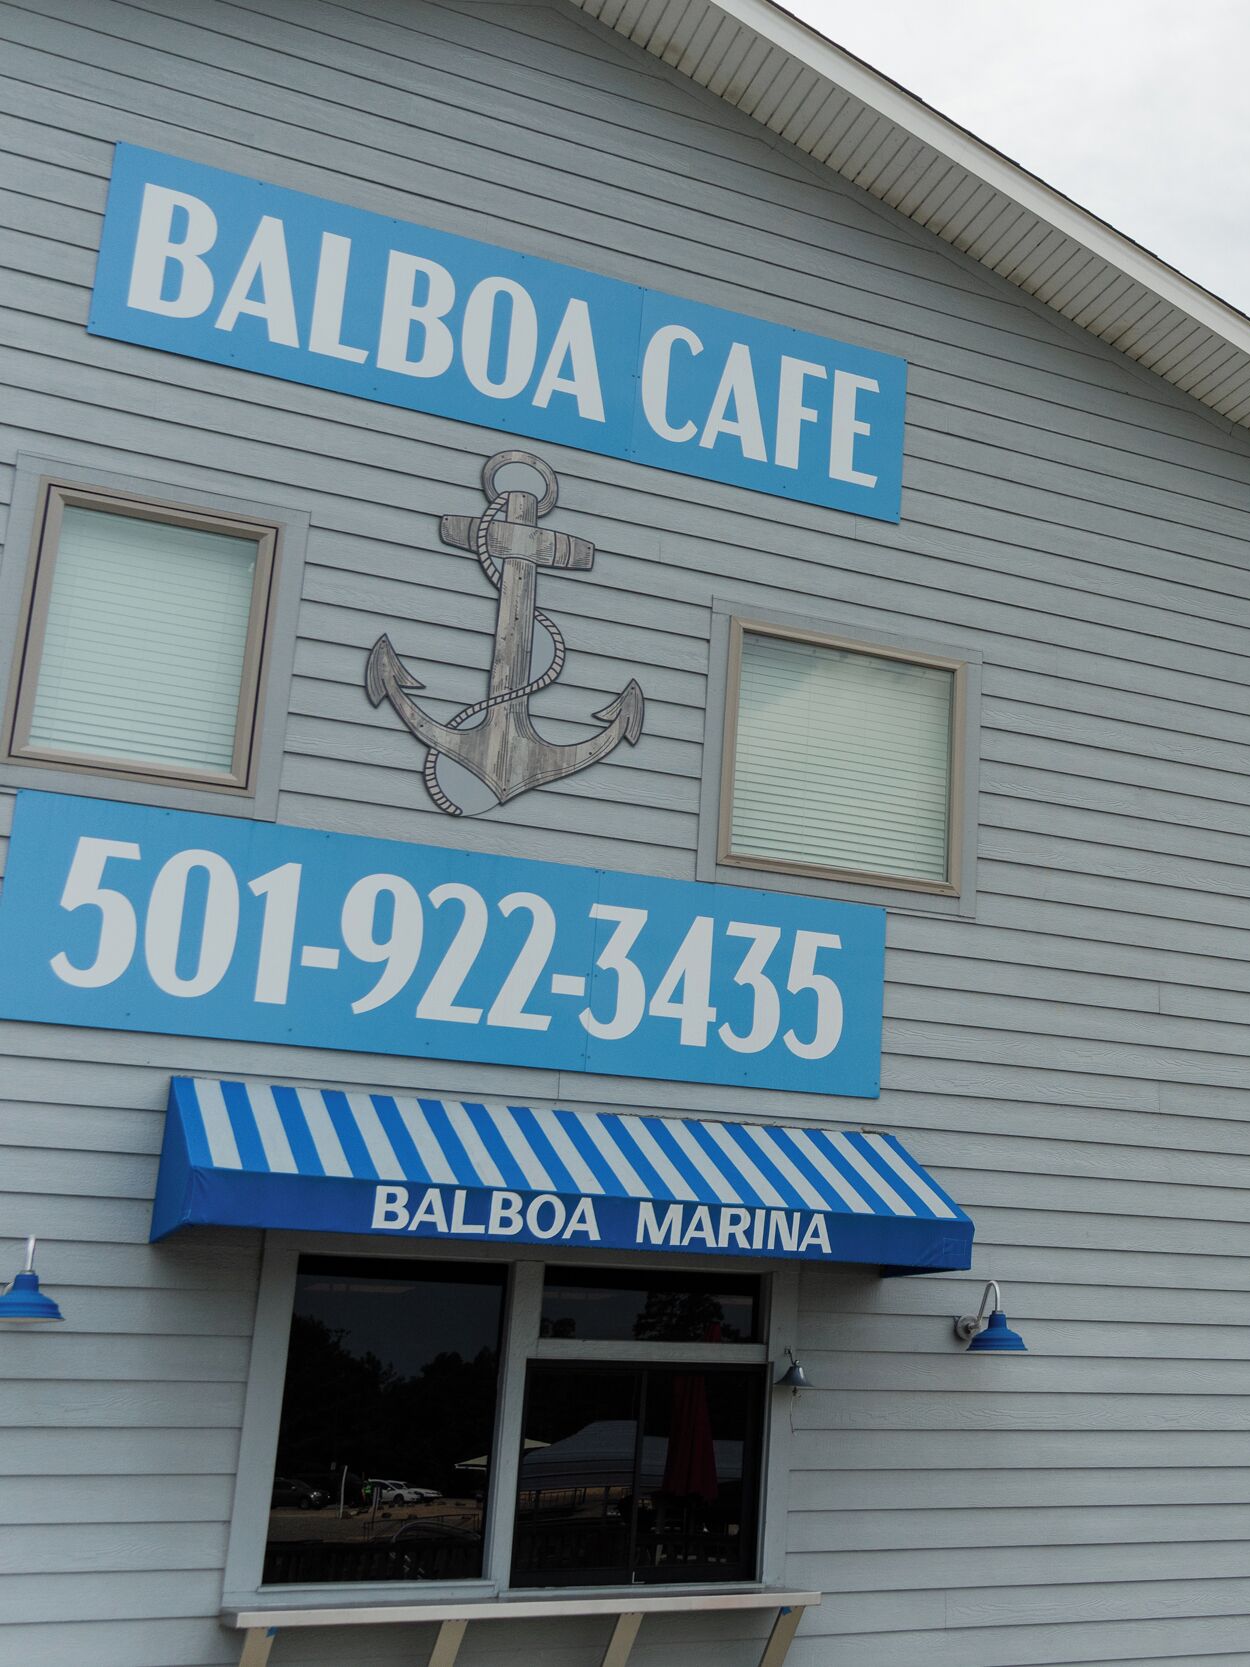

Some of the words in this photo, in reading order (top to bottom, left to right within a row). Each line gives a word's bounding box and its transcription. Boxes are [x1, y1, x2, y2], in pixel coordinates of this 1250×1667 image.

[127, 182, 606, 424] BALBOA
[641, 324, 882, 489] CAFE
[49, 836, 845, 1061] 501-922-3435
[371, 1185, 601, 1243] BALBOA
[636, 1203, 833, 1255] MARINA
